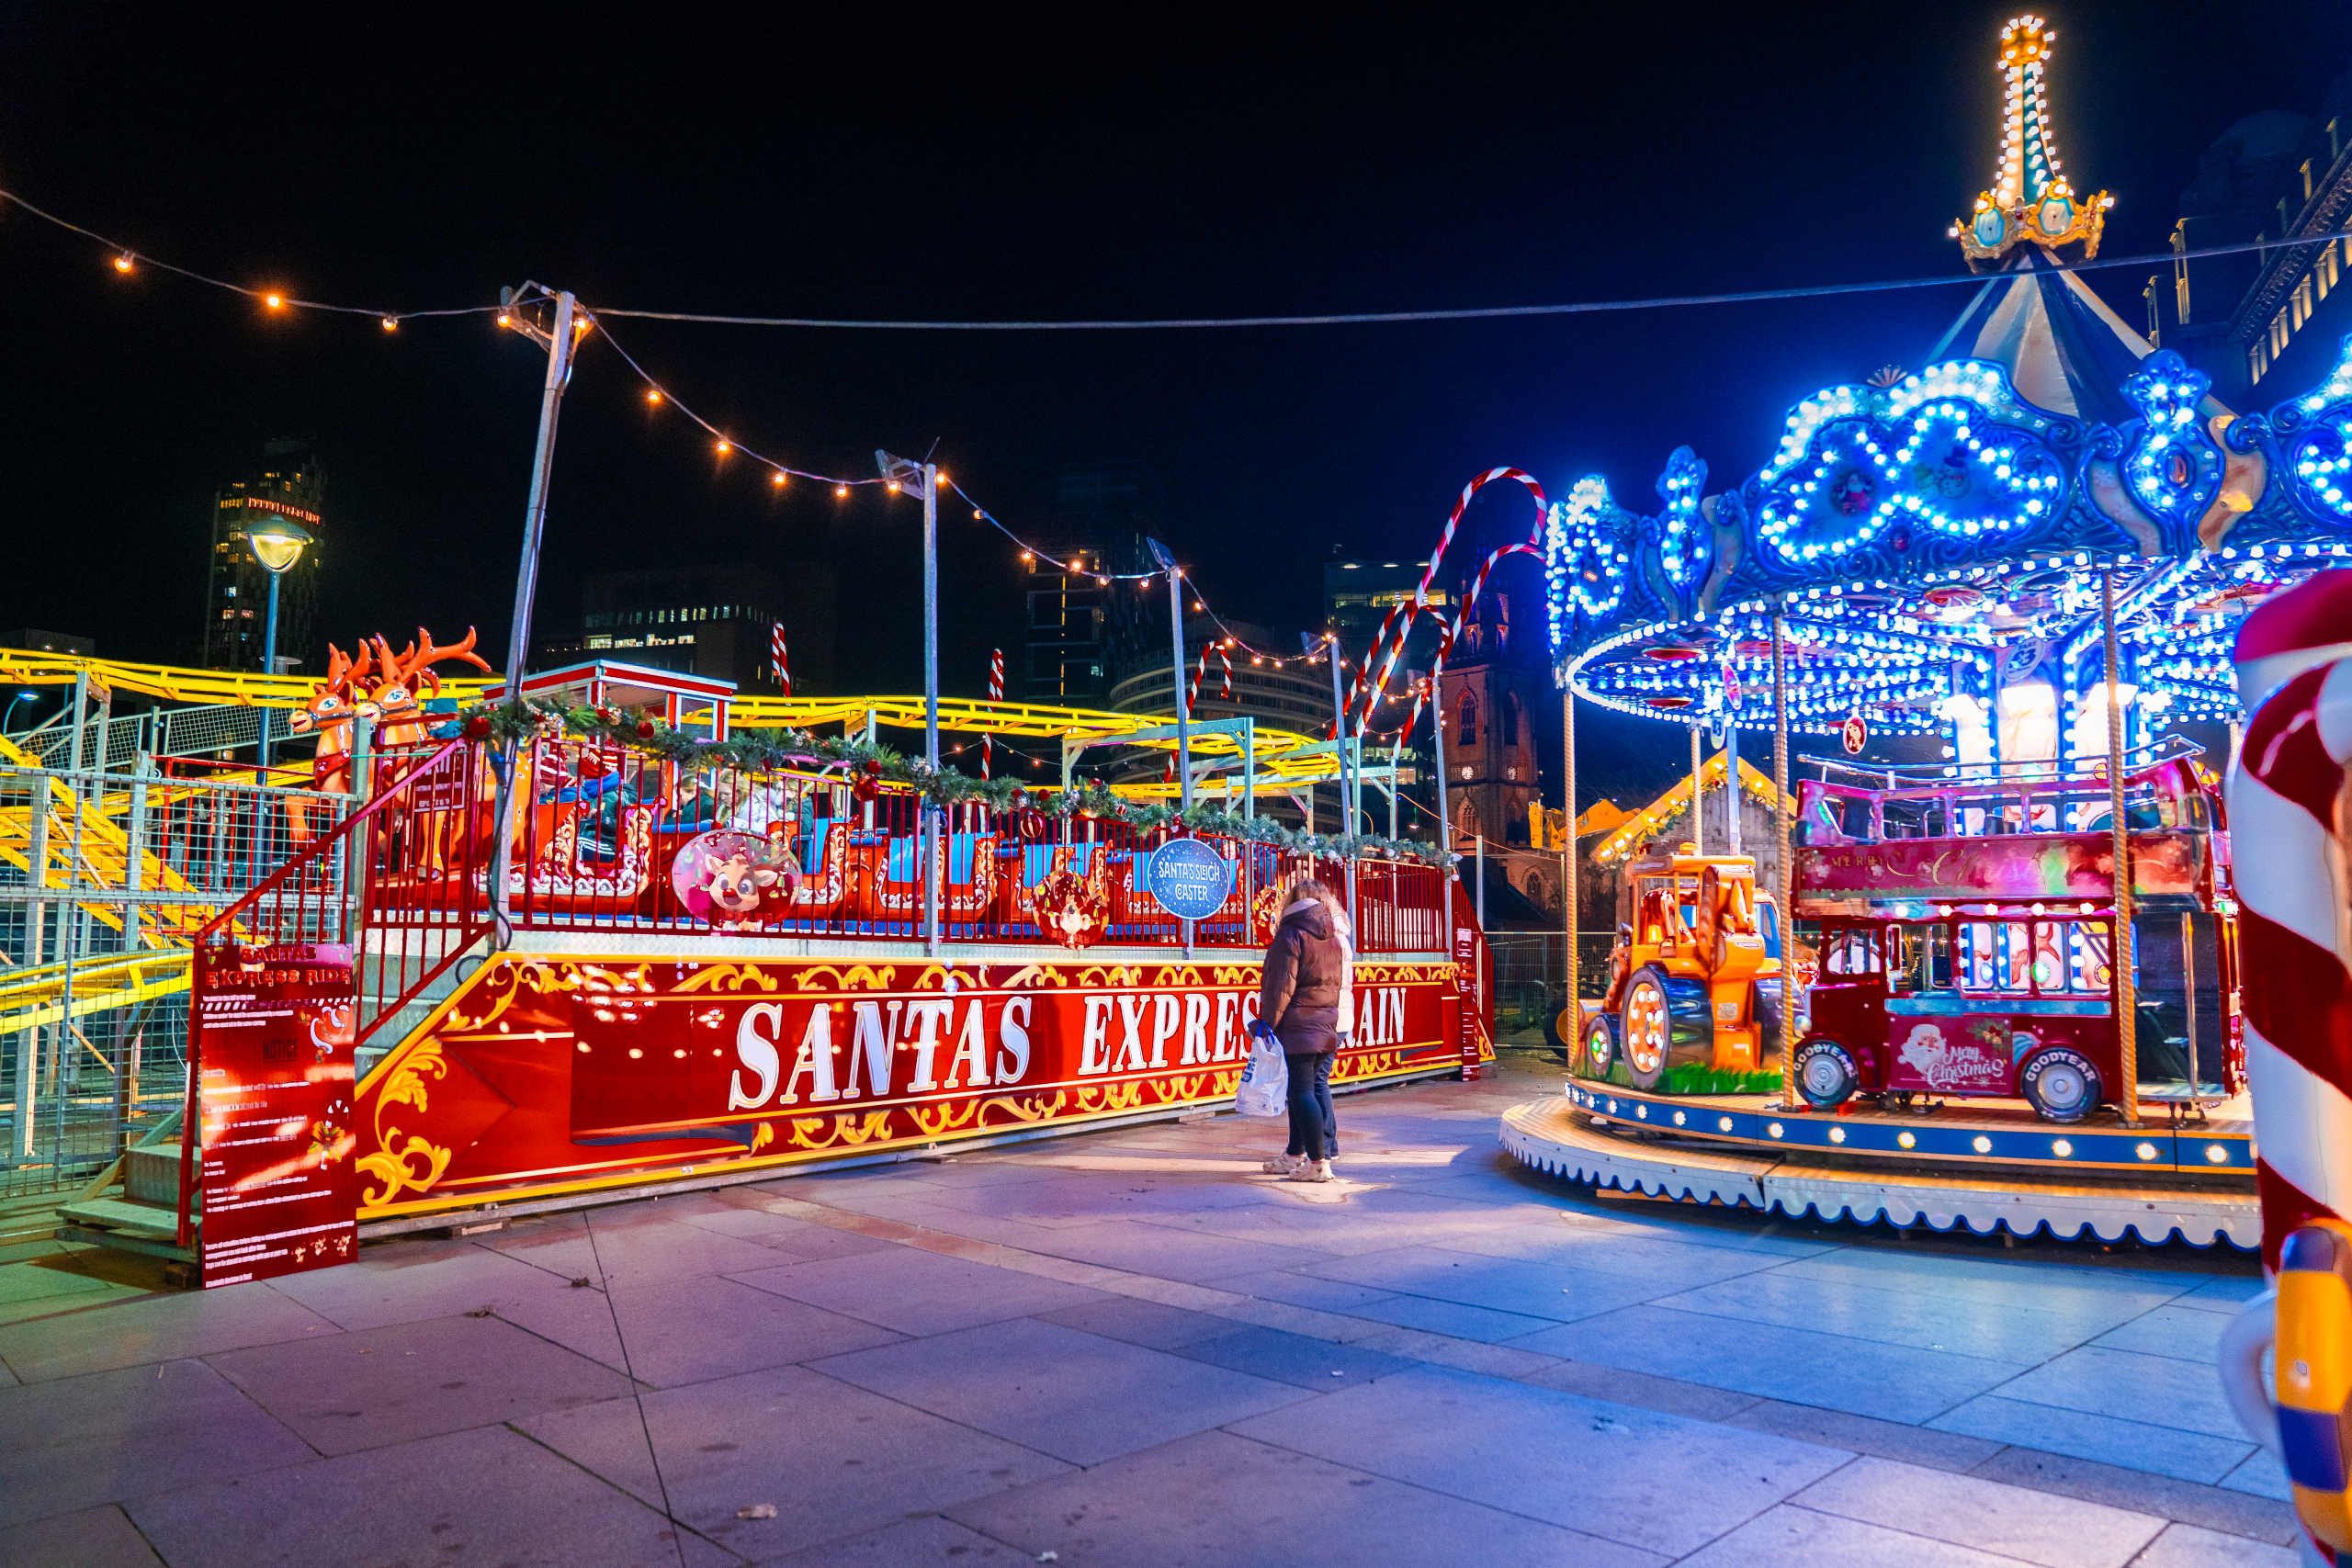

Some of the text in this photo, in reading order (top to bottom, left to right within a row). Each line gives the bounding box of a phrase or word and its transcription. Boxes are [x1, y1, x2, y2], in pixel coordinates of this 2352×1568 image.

[1158, 860, 1221, 882] SANTA'S SLEIGH
[241, 947, 317, 962] SANTAS
[205, 969, 350, 988] EXPRESS RIDE
[263, 1039, 299, 1061] NOTICE
[729, 987, 1407, 1111] SANTAS EXPRES AIN
[1942, 1045, 1979, 1065] Merry
[2026, 1052, 2096, 1081] GOODYEAR
